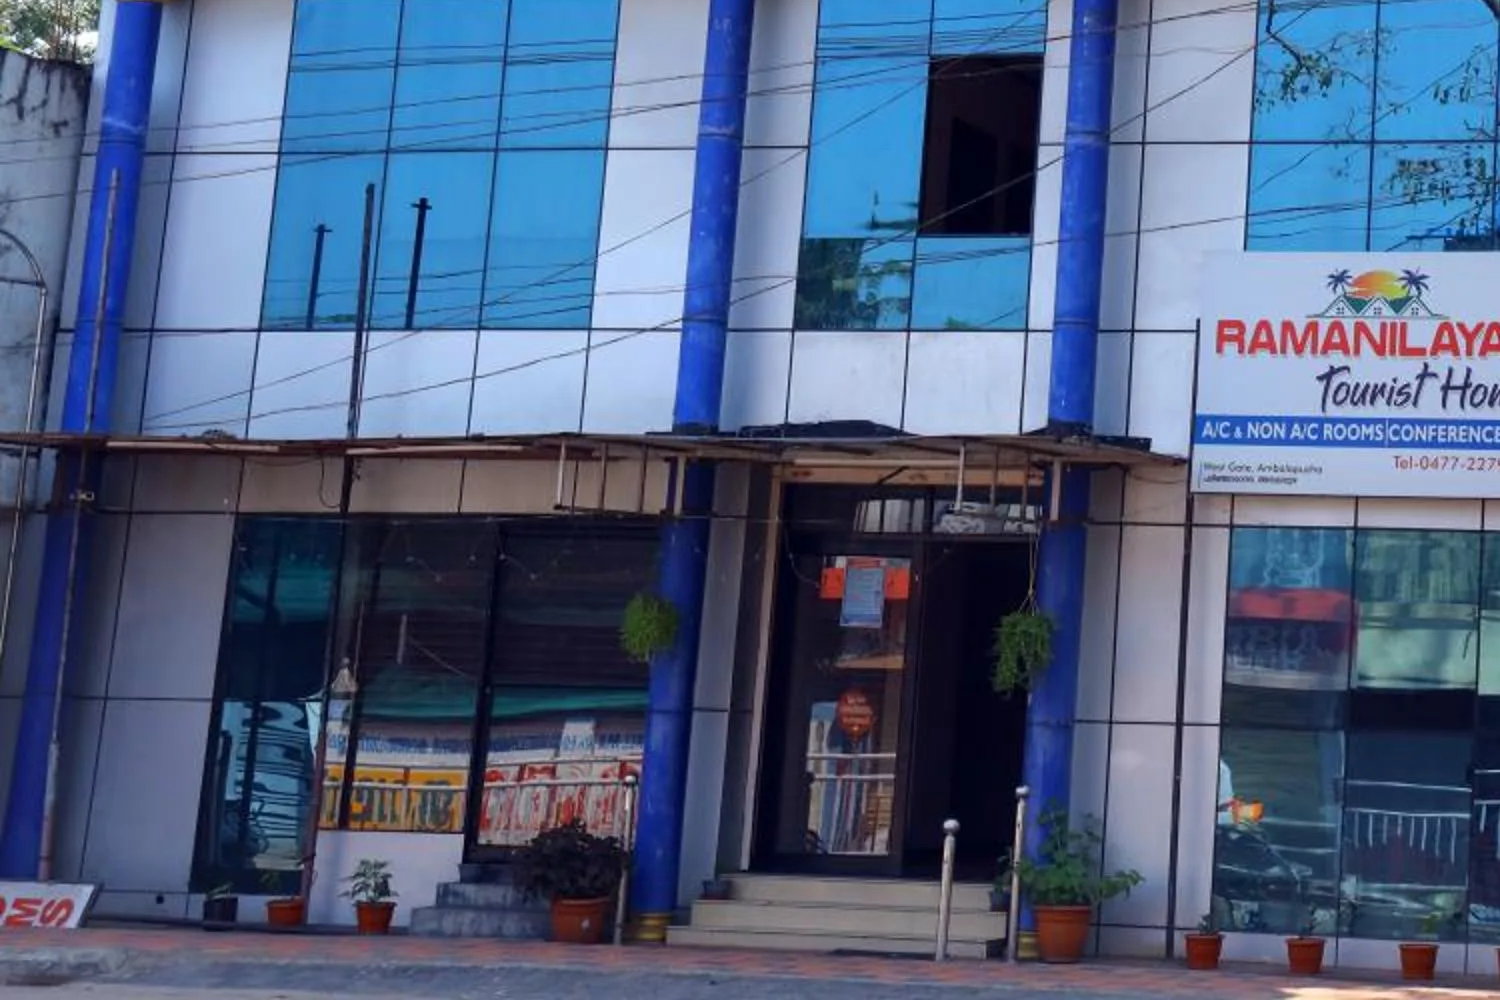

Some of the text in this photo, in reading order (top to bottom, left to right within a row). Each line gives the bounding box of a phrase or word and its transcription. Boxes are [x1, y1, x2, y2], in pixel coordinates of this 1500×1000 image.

[1315, 361, 1438, 414] Tourist
[1202, 421, 1231, 439] A/C
[1234, 426, 1242, 439] &
[1247, 422, 1285, 440] NON
[1290, 423, 1319, 440] A/C
[1323, 423, 1384, 442] ROOMS
